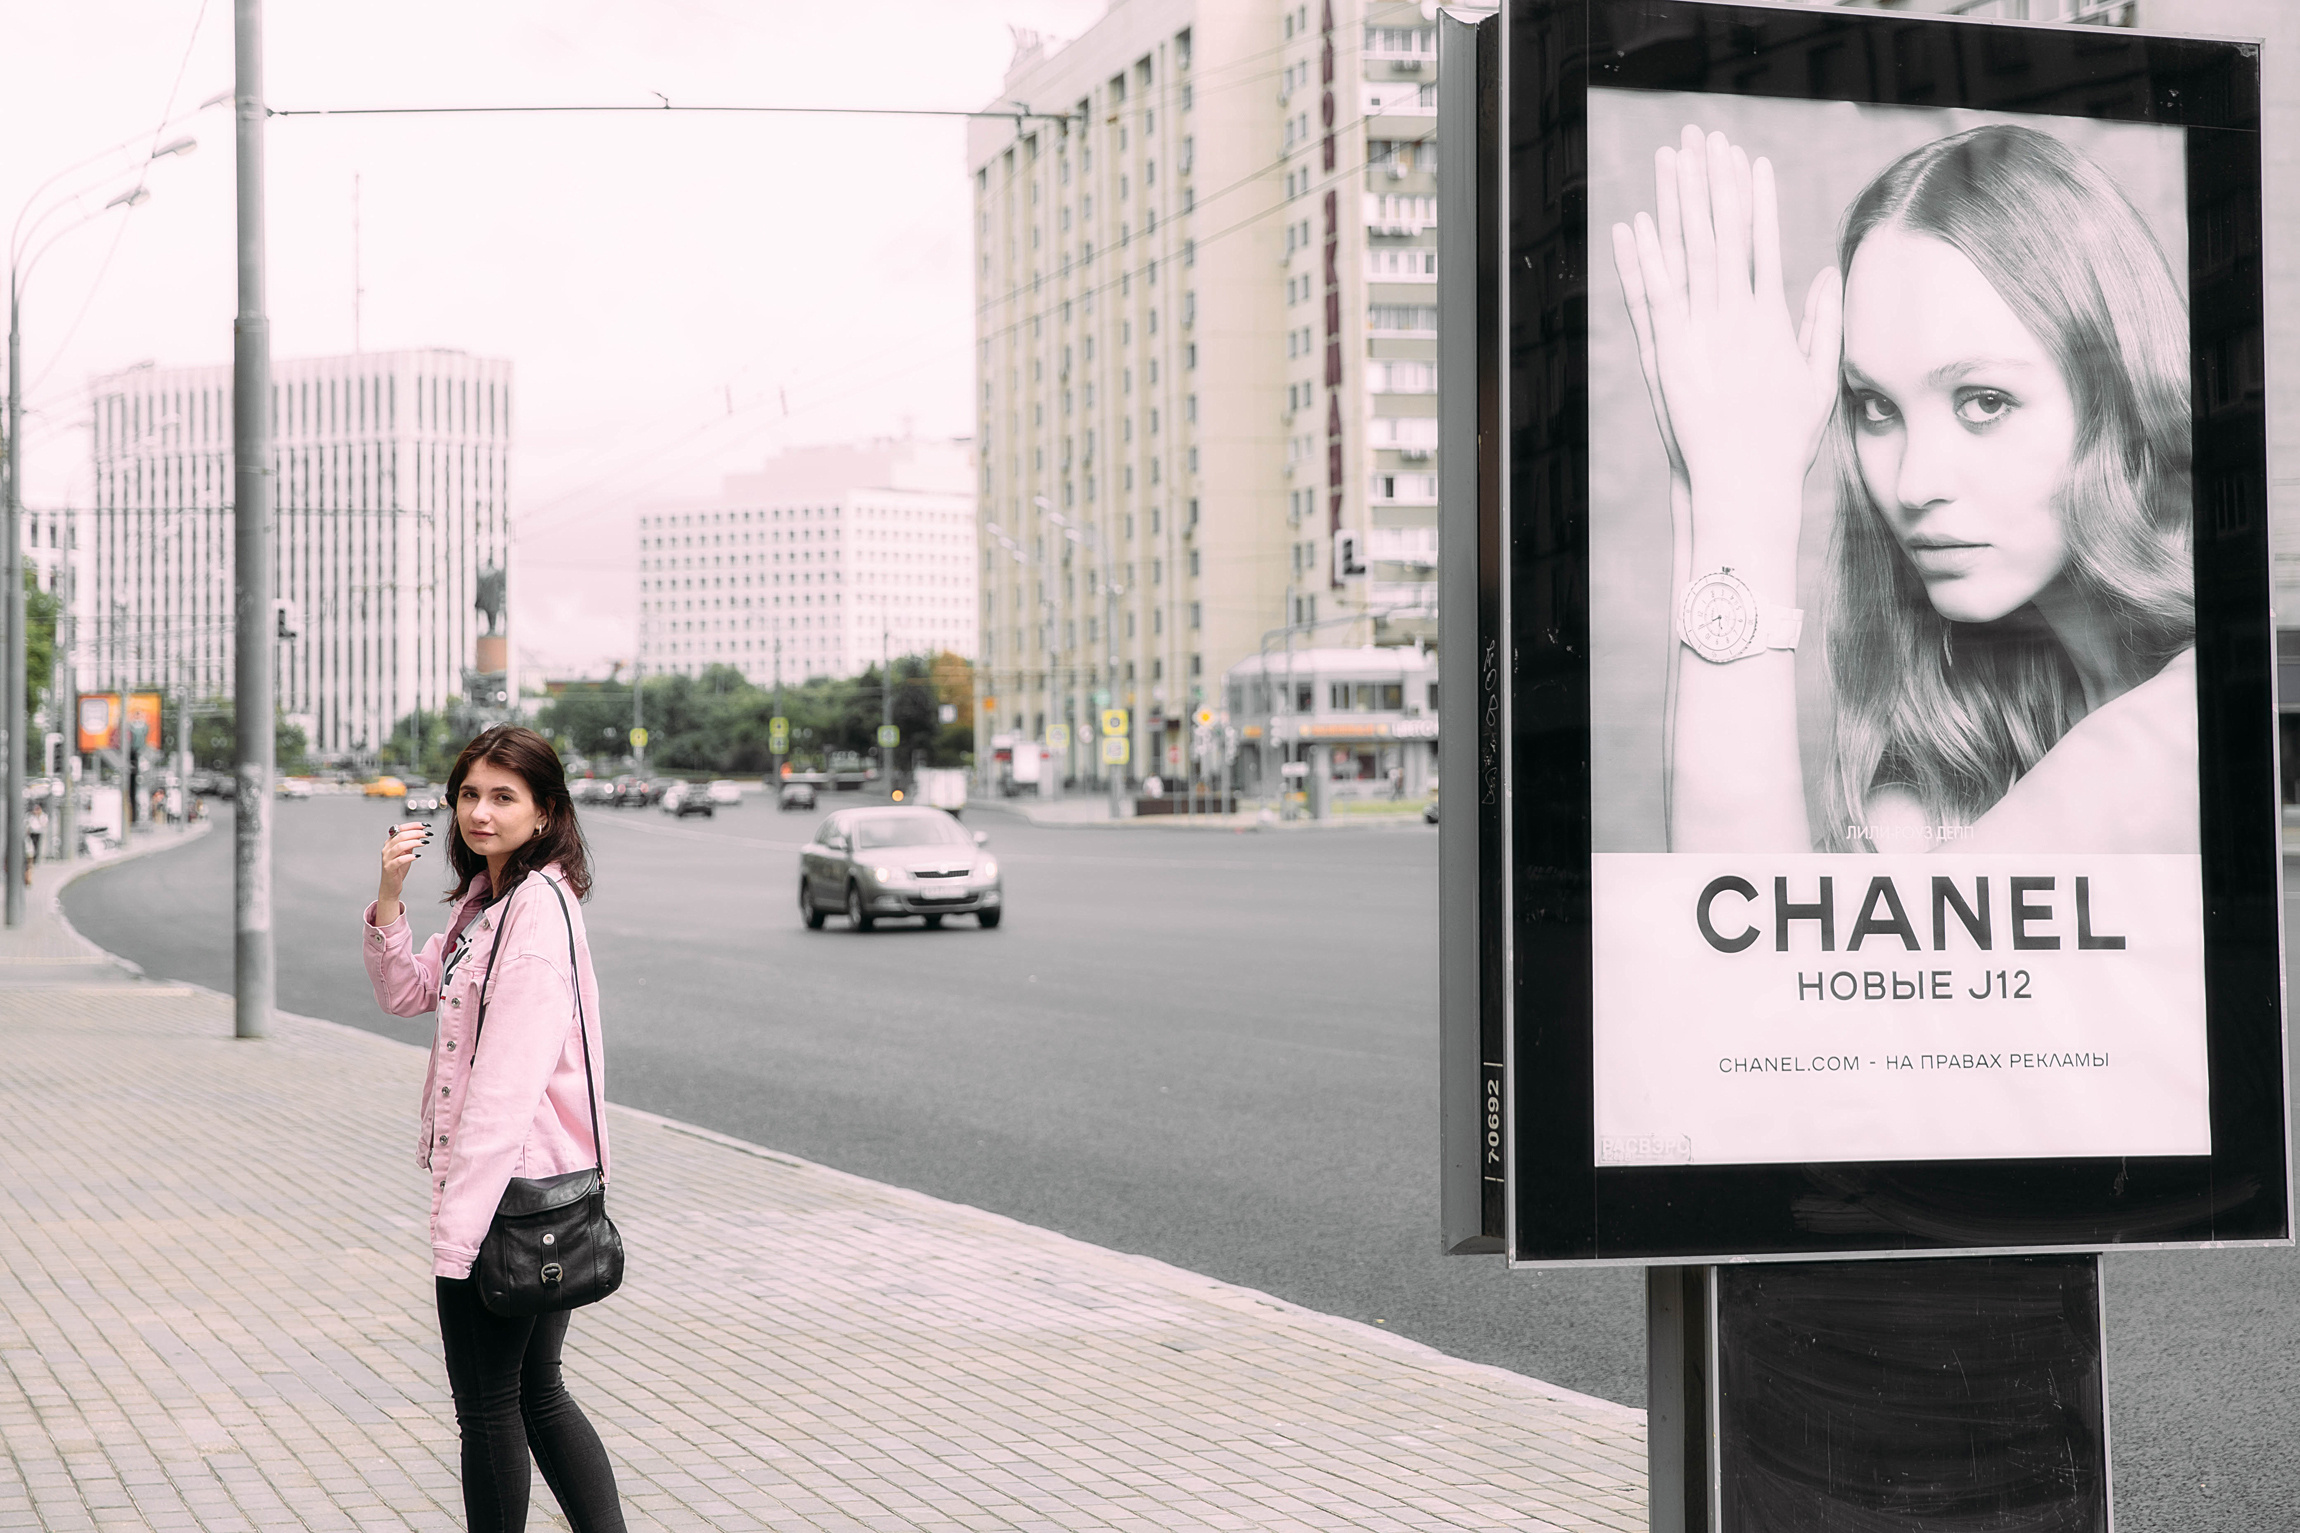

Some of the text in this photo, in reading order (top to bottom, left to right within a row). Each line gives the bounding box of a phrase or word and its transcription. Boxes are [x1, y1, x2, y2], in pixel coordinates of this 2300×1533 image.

[1936, 825, 1974, 842] ДЕПП
[1696, 875, 2126, 954] CHANEL
[1798, 969, 2032, 1001] НОВЫЕ J12
[1719, 1055, 1860, 1073] CHANEL.COM
[1886, 1055, 1914, 1070] НА
[1921, 1053, 2002, 1070] ПРАВАХ
[2010, 1052, 2109, 1069] РЕКЛАМЫ
[1487, 1079, 1499, 1164] 70692
